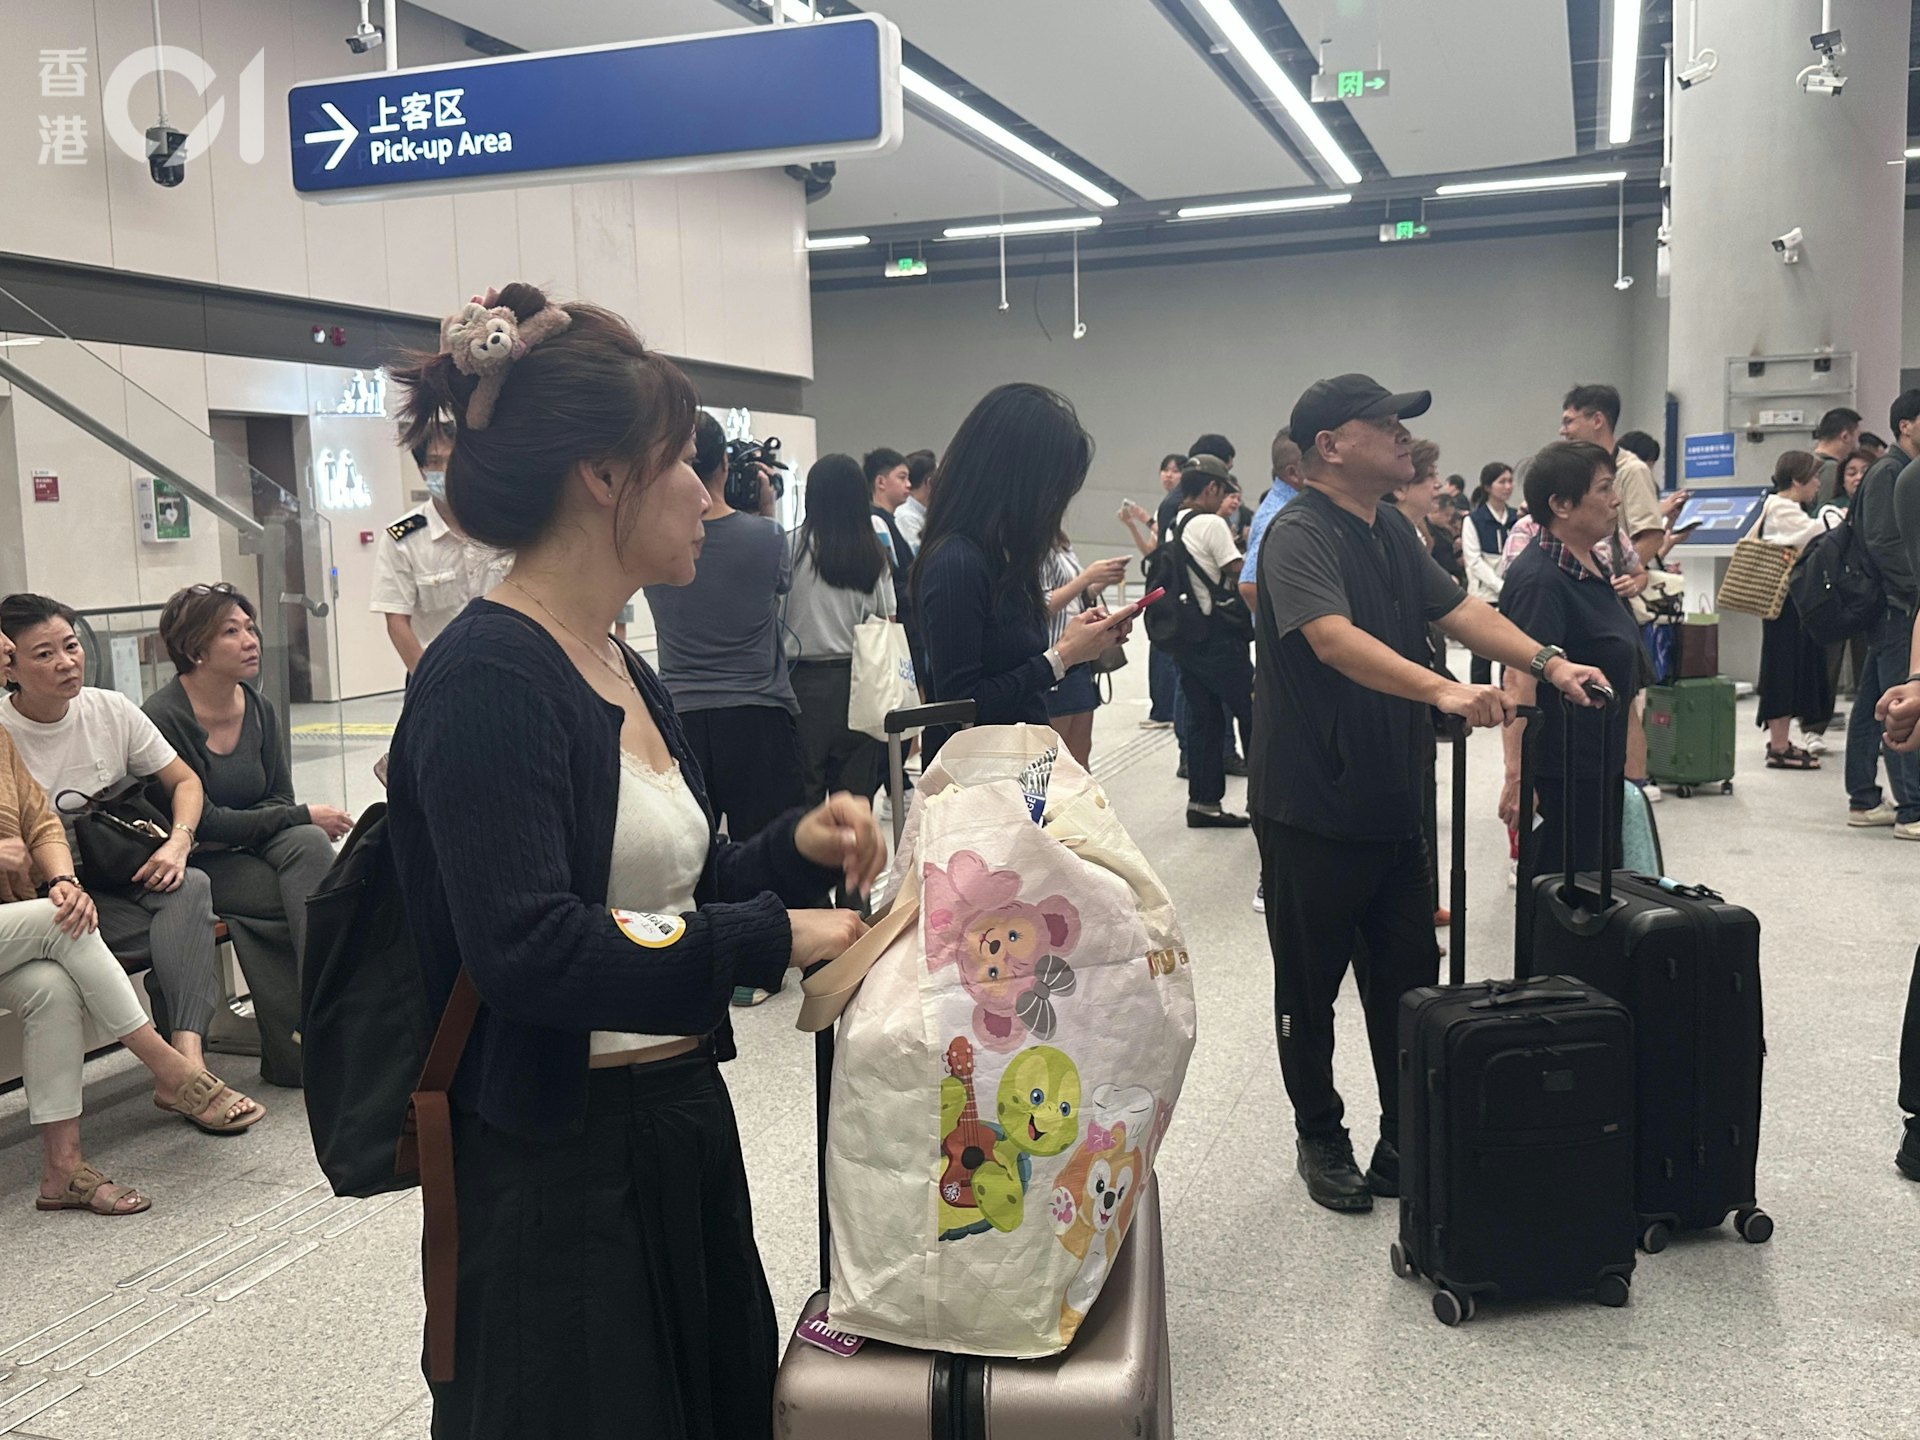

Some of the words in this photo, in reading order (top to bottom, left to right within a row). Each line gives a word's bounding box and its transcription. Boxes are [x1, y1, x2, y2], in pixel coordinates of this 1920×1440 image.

[369, 88, 467, 133] 上客区
[370, 136, 453, 165] Pick-up
[457, 130, 513, 157] Area
